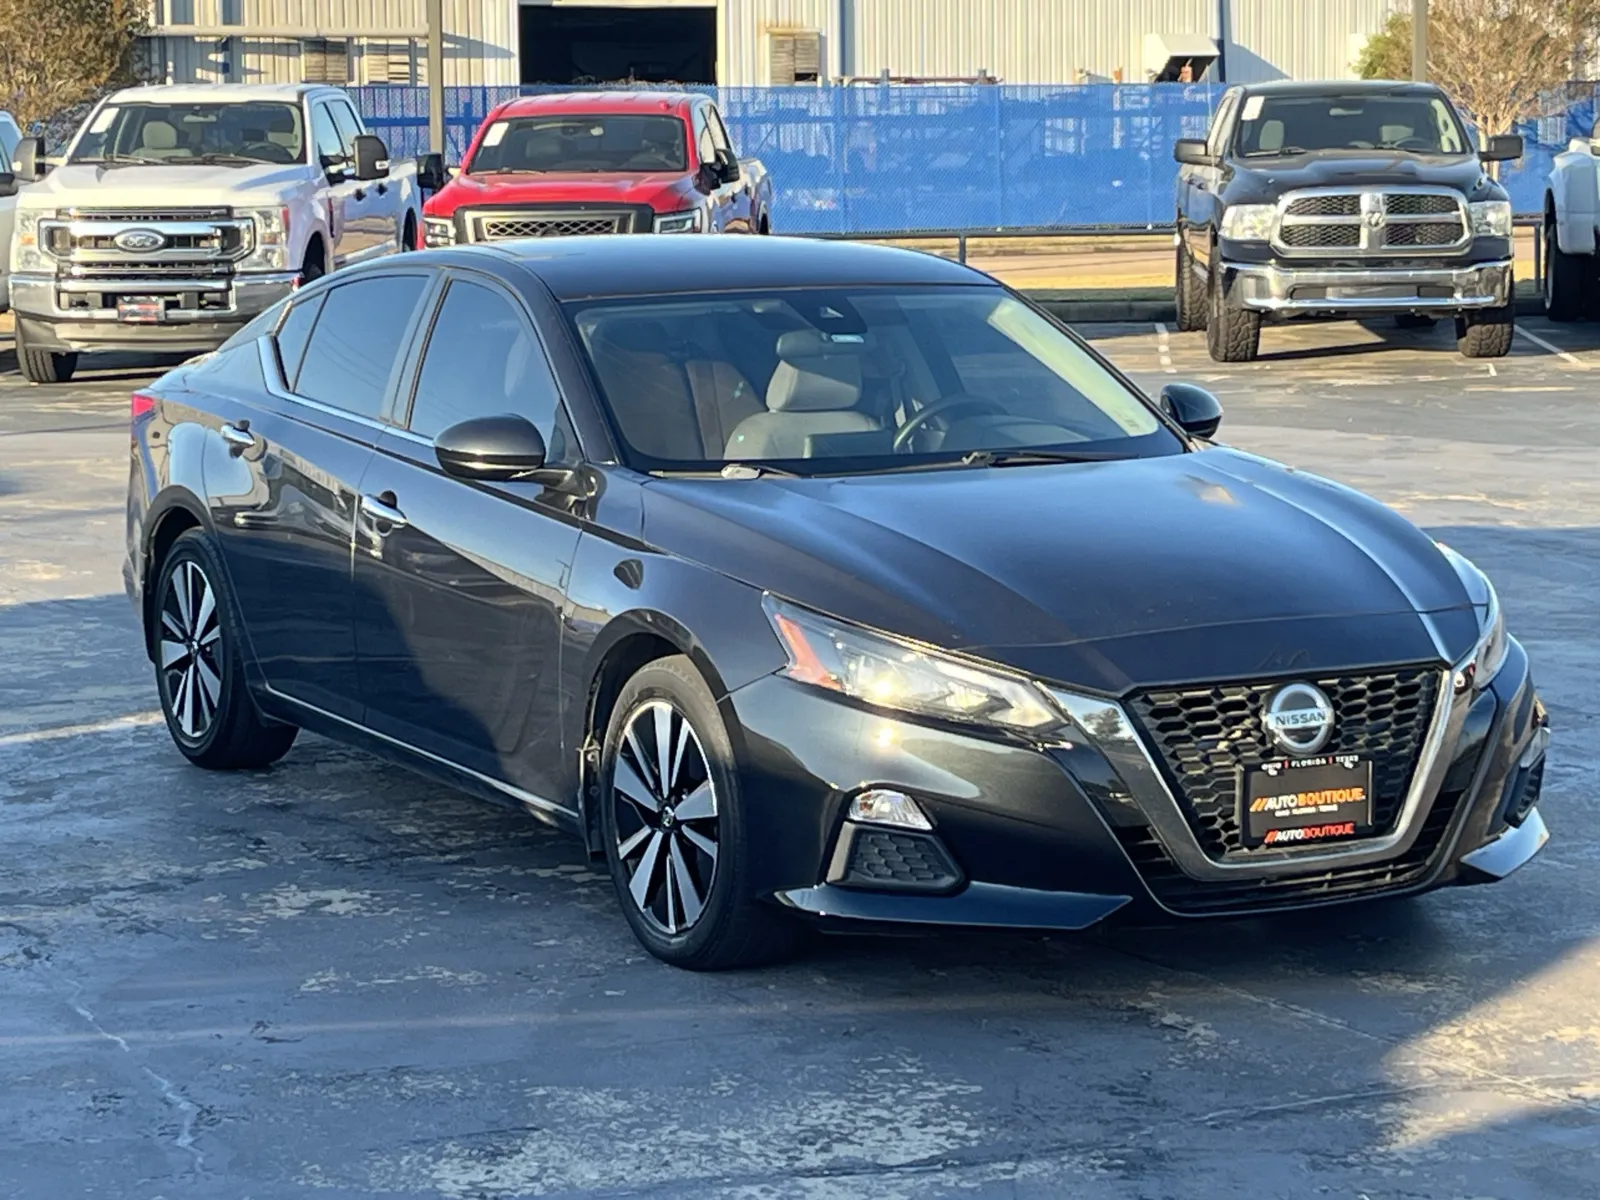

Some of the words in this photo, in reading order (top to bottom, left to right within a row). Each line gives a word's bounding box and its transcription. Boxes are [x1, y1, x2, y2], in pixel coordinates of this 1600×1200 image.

[1275, 712, 1326, 725] NISSAN
[1290, 757, 1327, 767] FLORIDA
[1274, 823, 1355, 842] AUTOBOUTIQUE
